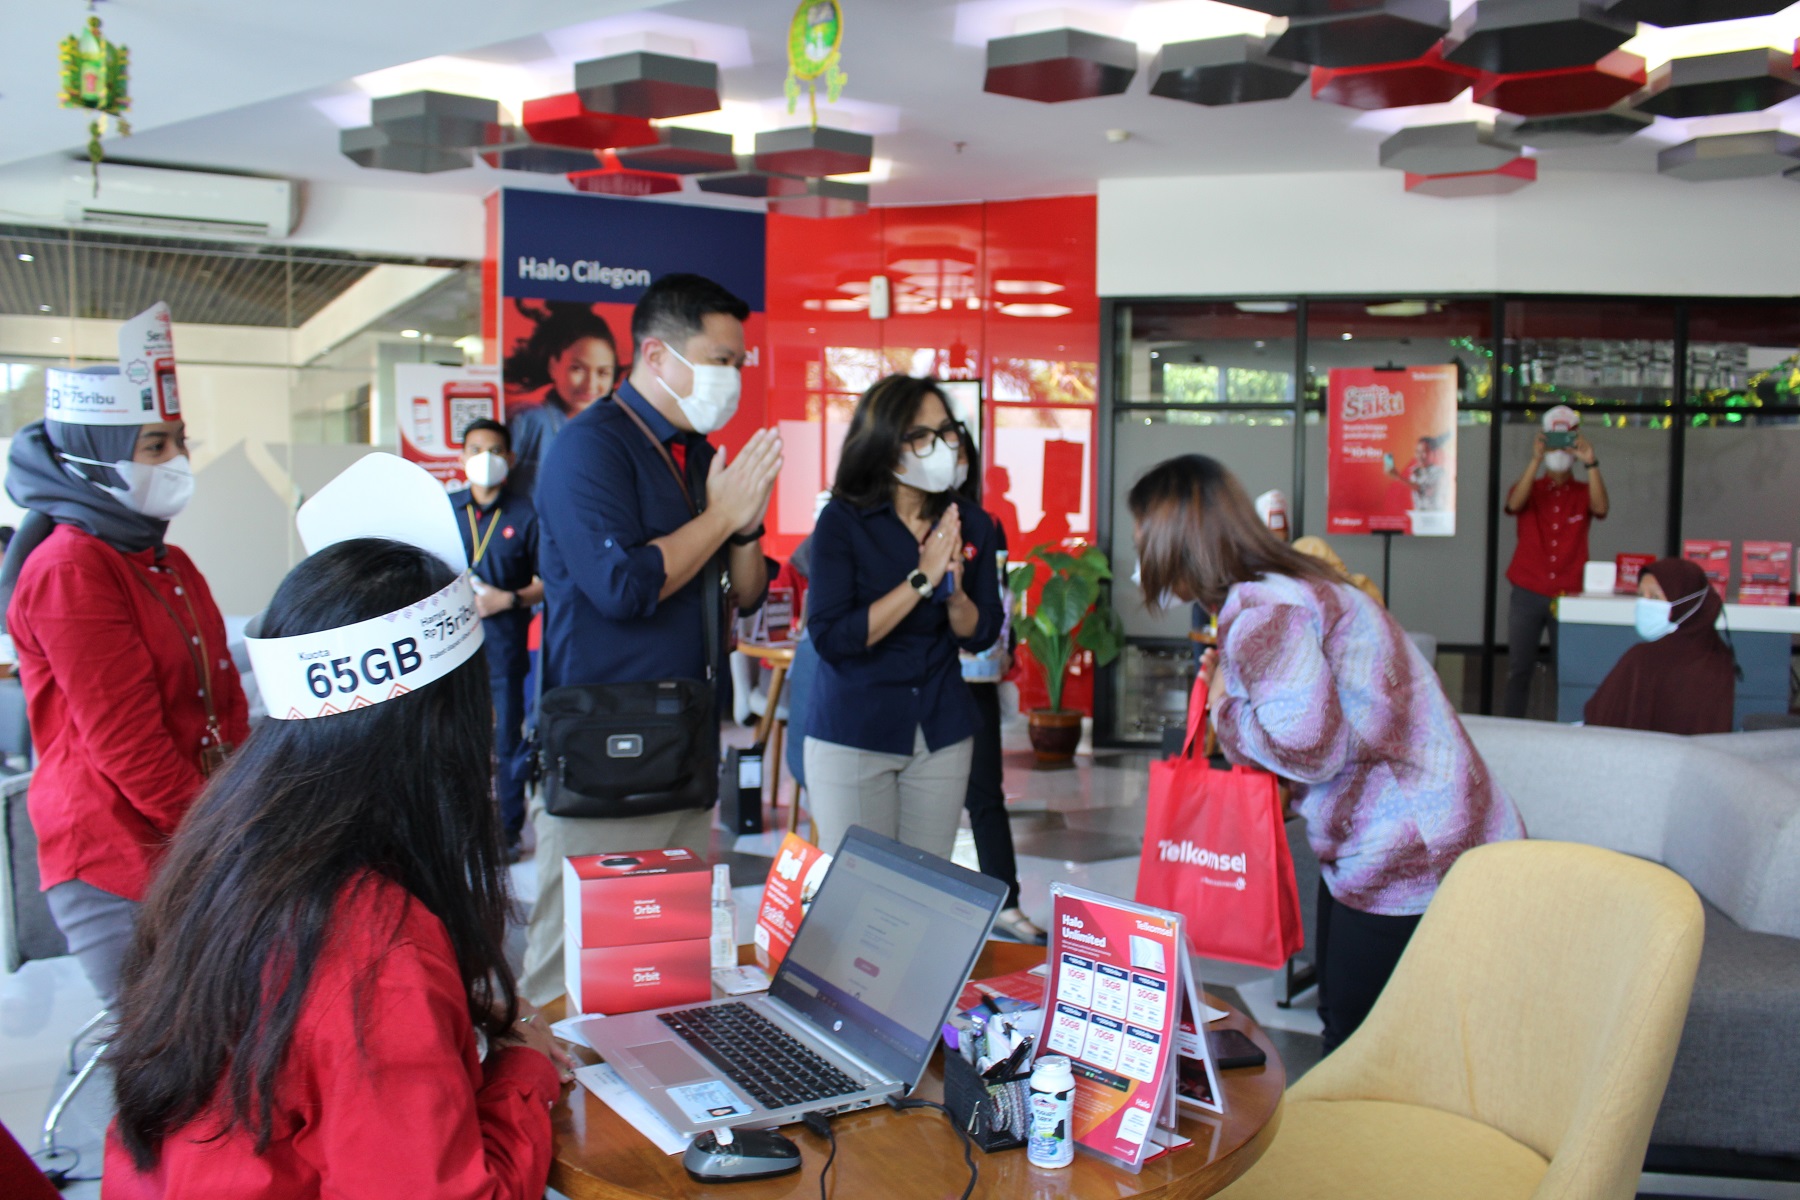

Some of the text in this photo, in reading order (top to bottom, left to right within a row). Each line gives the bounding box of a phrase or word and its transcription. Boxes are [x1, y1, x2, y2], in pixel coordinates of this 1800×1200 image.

[519, 256, 652, 290] Halo Cilegon
[298, 649, 330, 661] Kuota
[306, 636, 422, 699] 65GB
[1157, 840, 1247, 874] Telkomsel
[633, 903, 662, 916] Orbit
[1062, 914, 1084, 929] Halo
[1135, 919, 1174, 937] Telkomsel
[1062, 927, 1107, 948] Unlimited
[633, 971, 661, 983] Orbit
